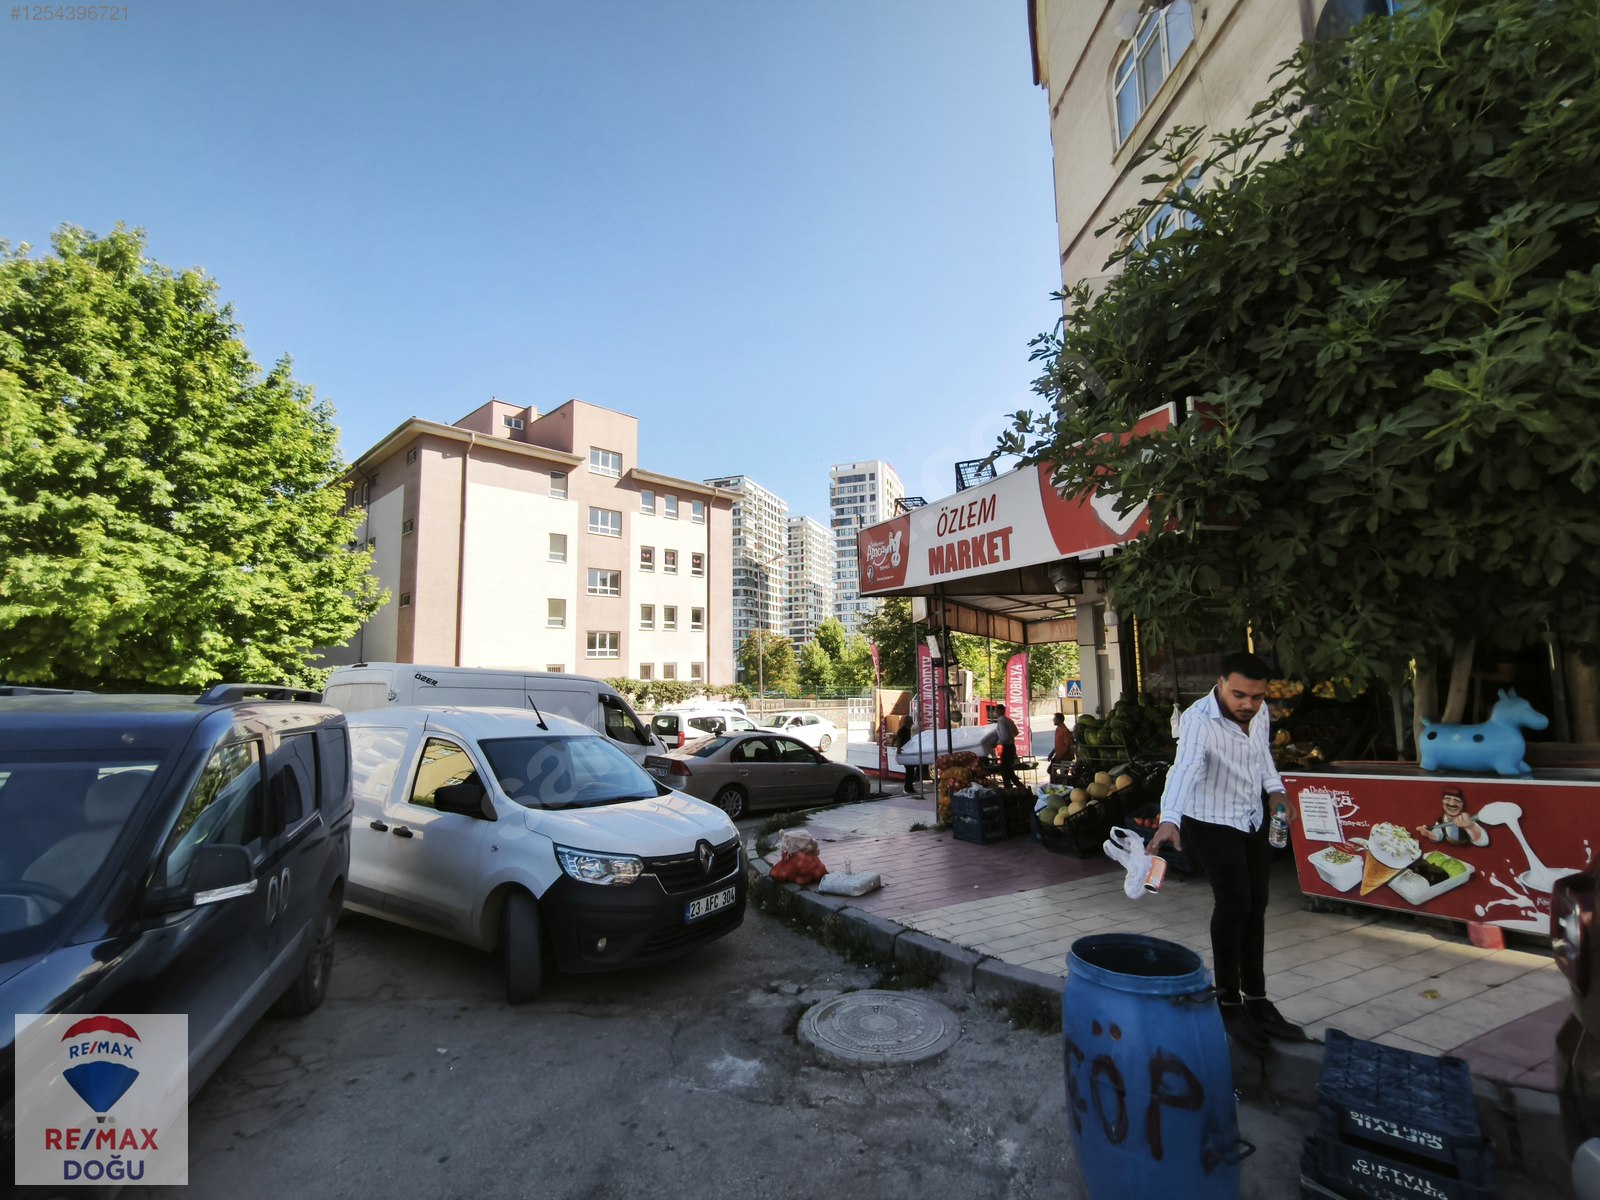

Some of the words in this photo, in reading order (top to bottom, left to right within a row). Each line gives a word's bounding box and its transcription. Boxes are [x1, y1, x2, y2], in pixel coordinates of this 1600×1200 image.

[936, 494, 996, 537] ÖZLEM
[928, 526, 1013, 576] MARKET
[690, 901, 701, 918] 23
[705, 894, 719, 912] AFC
[722, 889, 735, 905] 304
